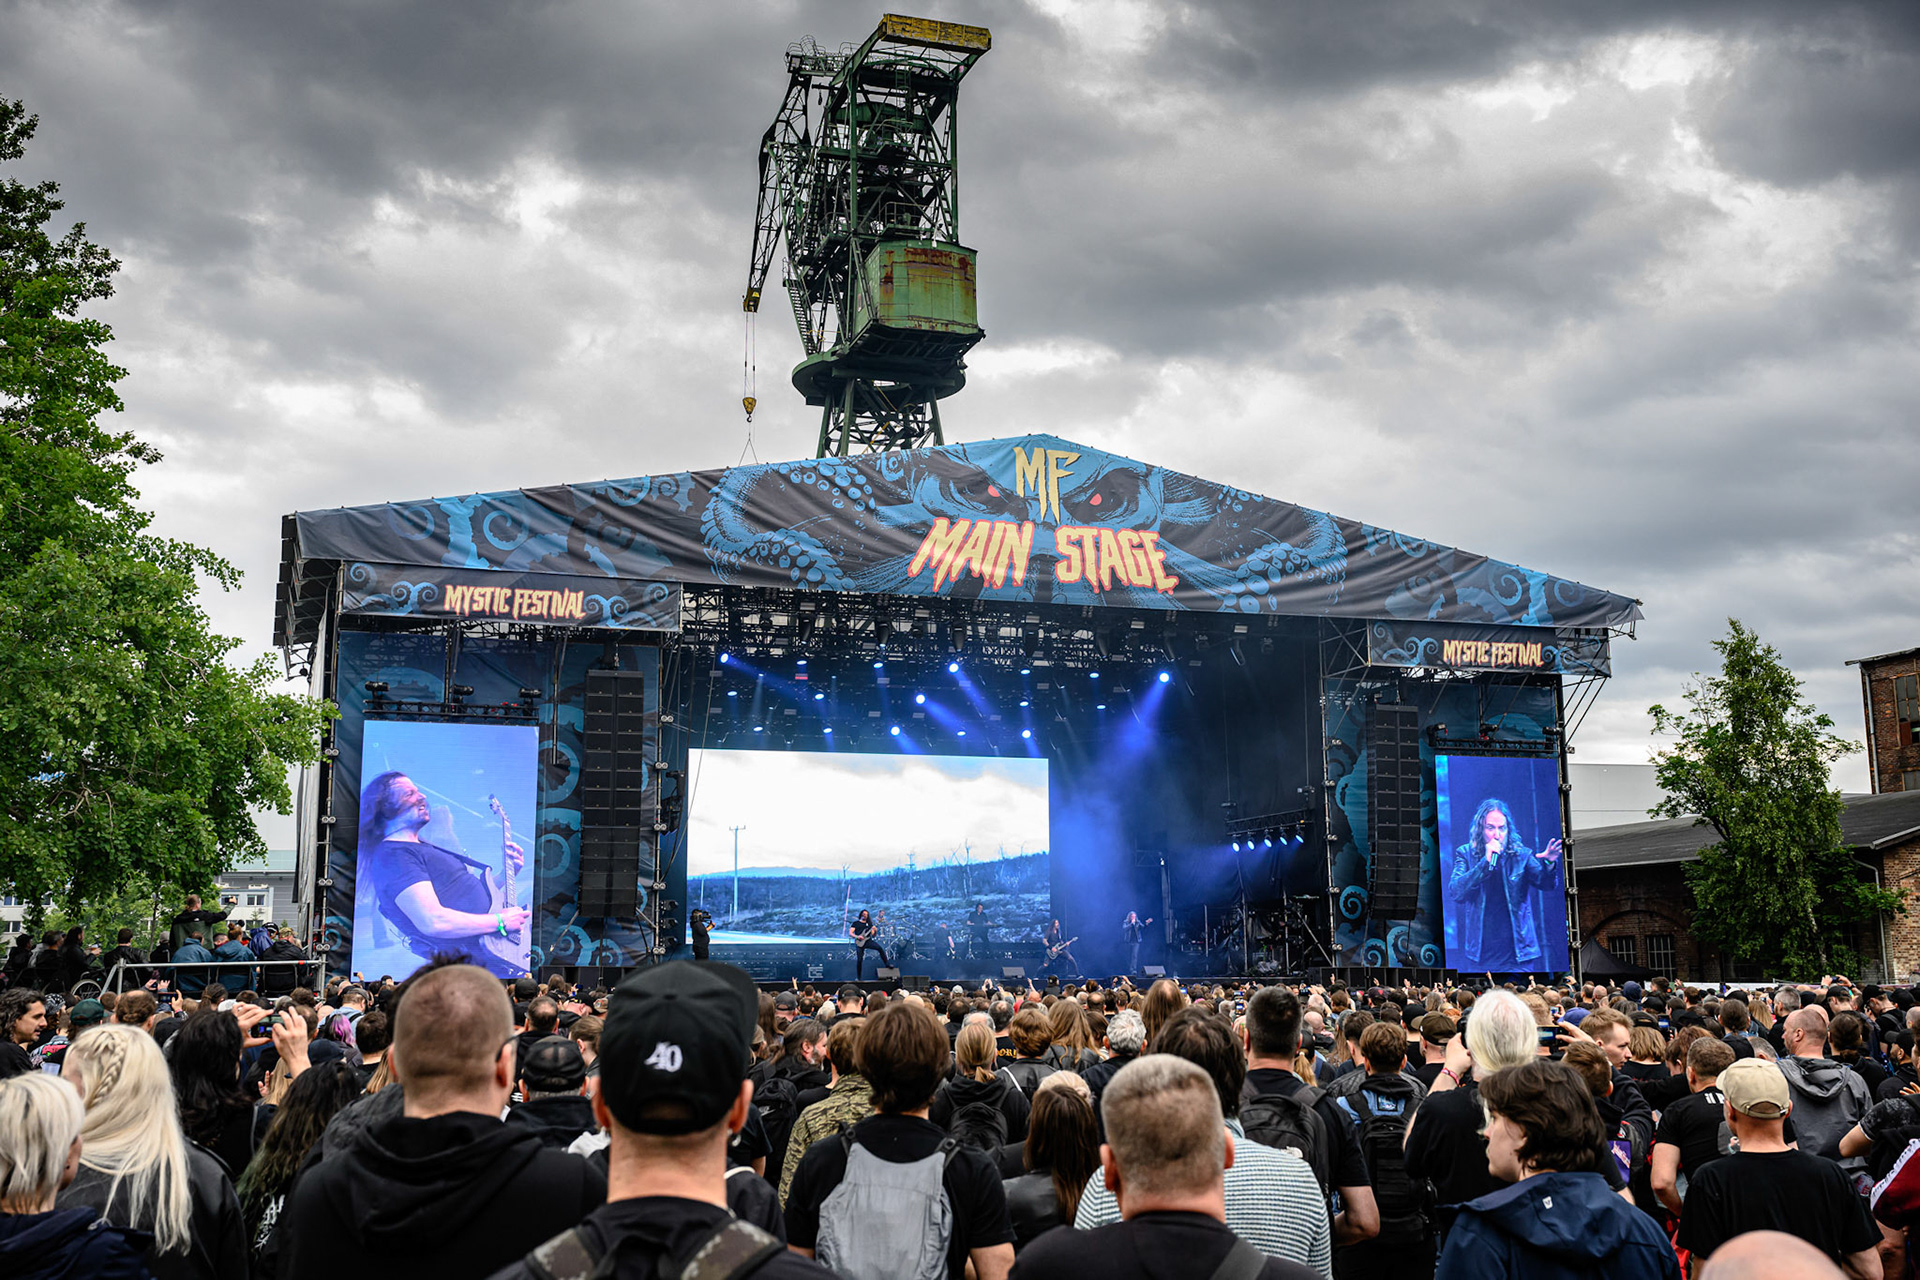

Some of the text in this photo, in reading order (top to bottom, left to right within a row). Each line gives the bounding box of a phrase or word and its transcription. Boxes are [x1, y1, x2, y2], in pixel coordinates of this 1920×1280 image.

[1013, 447, 1081, 524] MF
[908, 517, 1179, 595] MAIN STAGE
[444, 585, 586, 620] MYSTIC FESTIVAL
[1443, 639, 1544, 668] MYSTIC FESTIVAL
